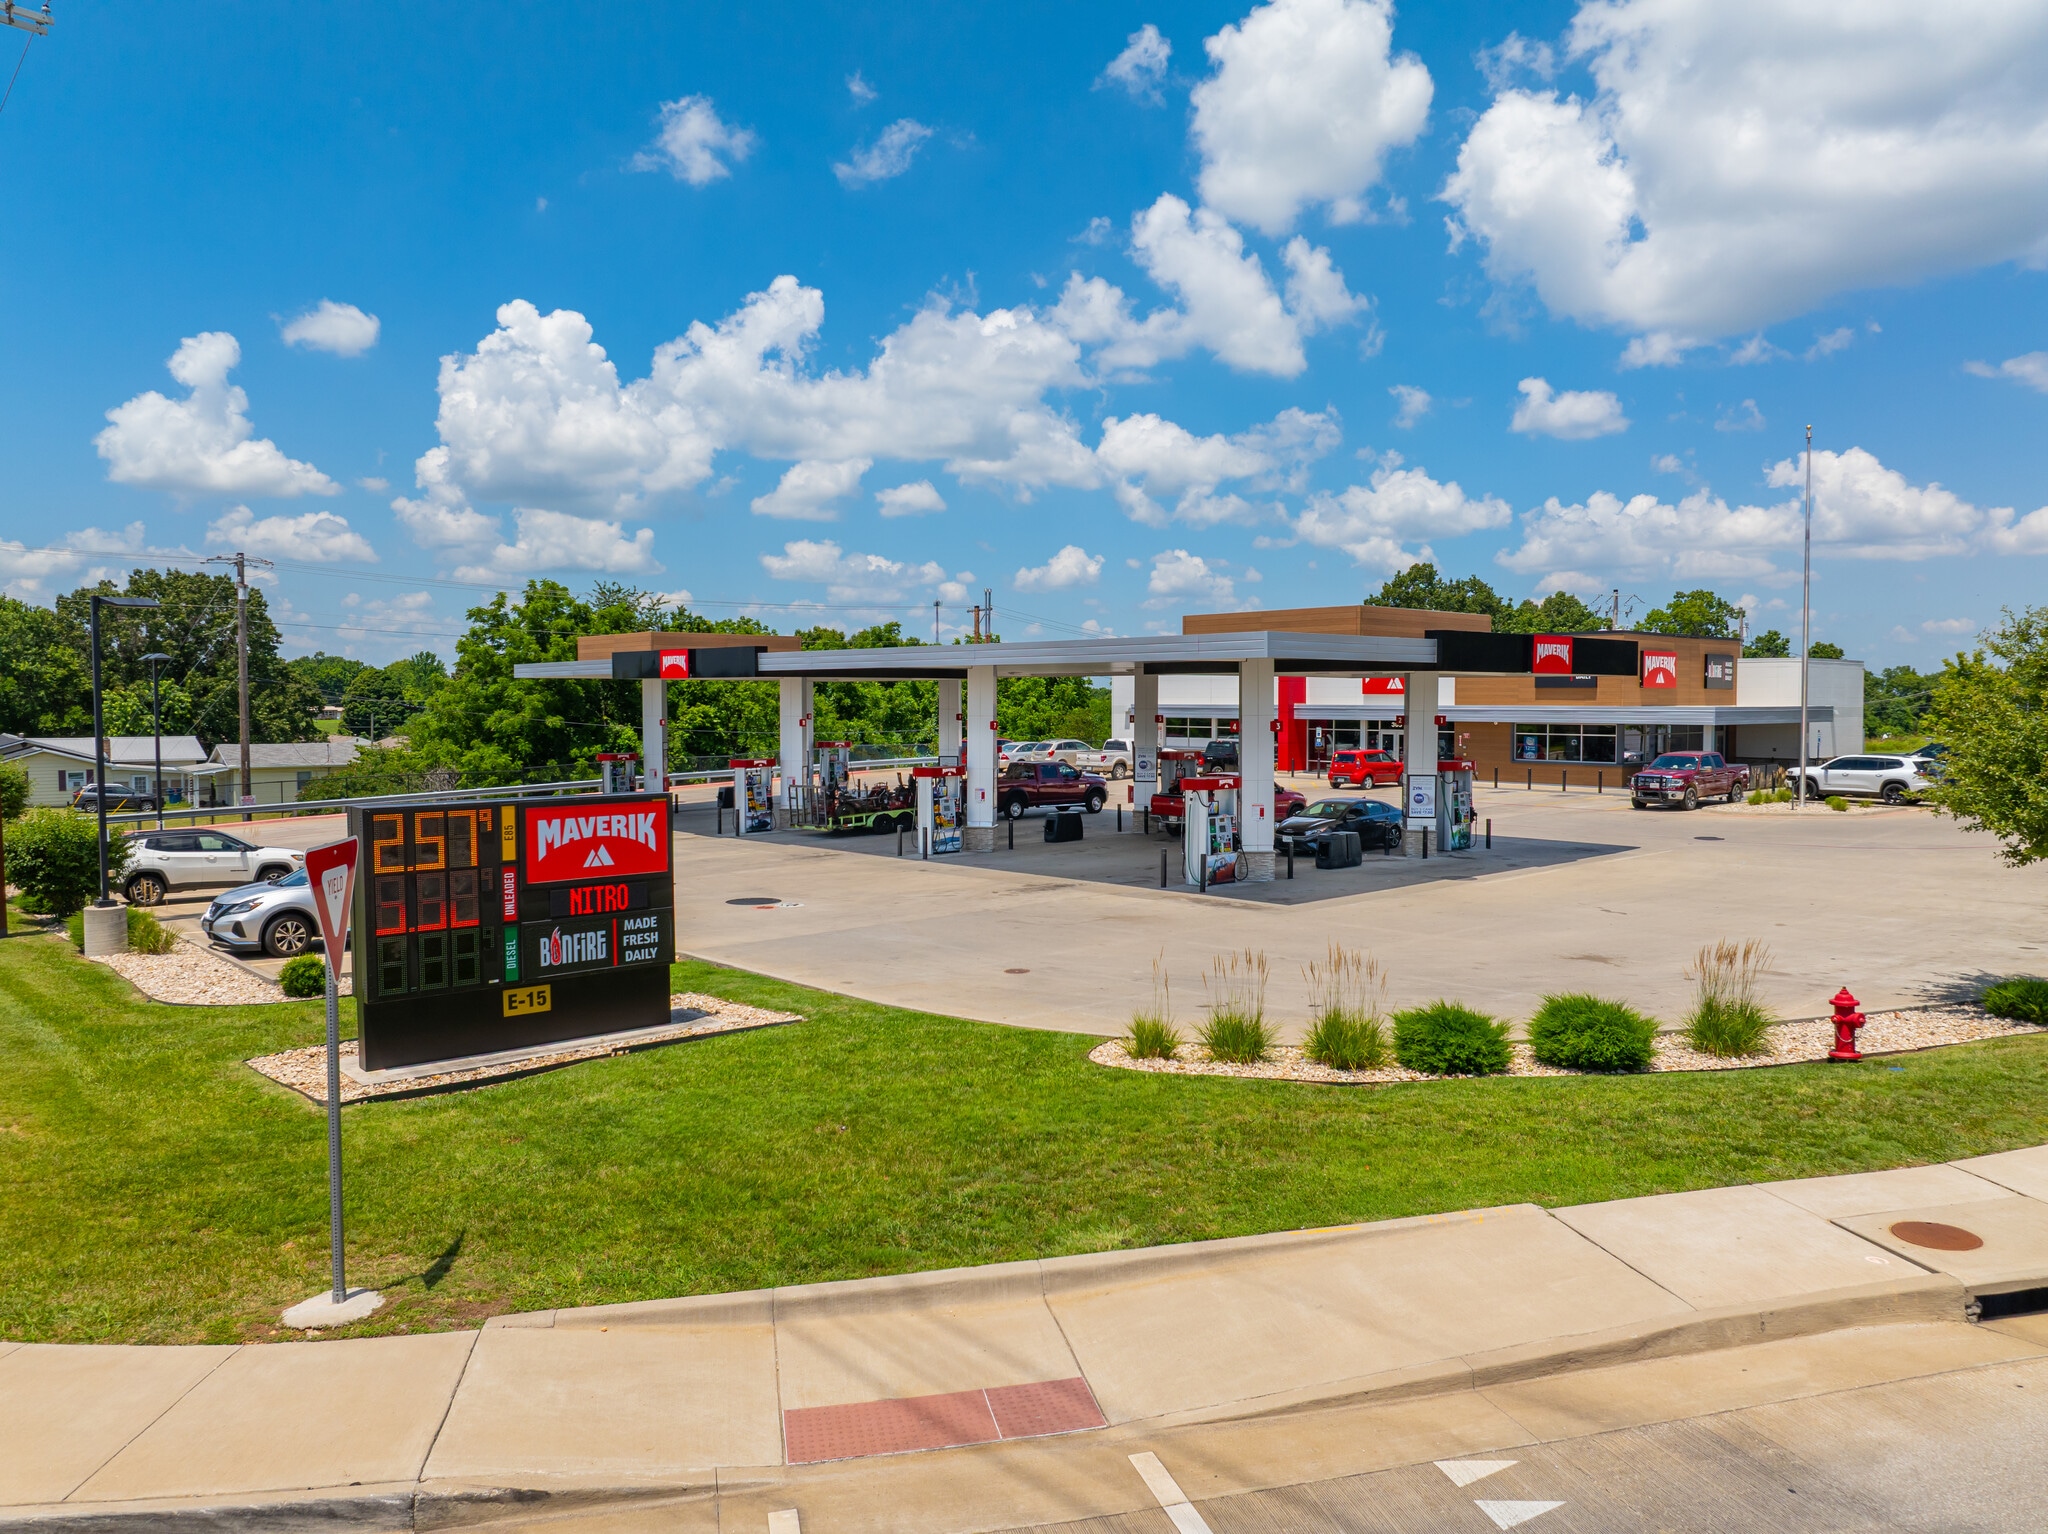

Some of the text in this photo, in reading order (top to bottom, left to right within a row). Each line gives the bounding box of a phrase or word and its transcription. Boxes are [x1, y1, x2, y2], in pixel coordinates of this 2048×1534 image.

[1536, 643, 1569, 666] MAVERIK
[1644, 655, 1676, 678] MAVERIK
[1276, 722, 1281, 730] 3
[504, 825, 514, 841] E85
[537, 812, 656, 862] MAVERIK
[327, 875, 344, 896] YIELD
[504, 872, 515, 915] UNLEADED
[569, 883, 629, 916] NITRO
[623, 916, 658, 931] MADE
[540, 926, 607, 967] BONFIRE
[623, 931, 659, 947] FRESH
[505, 939, 517, 969] DIESEL
[625, 947, 658, 962] DAILY
[508, 990, 547, 1011] E-15
